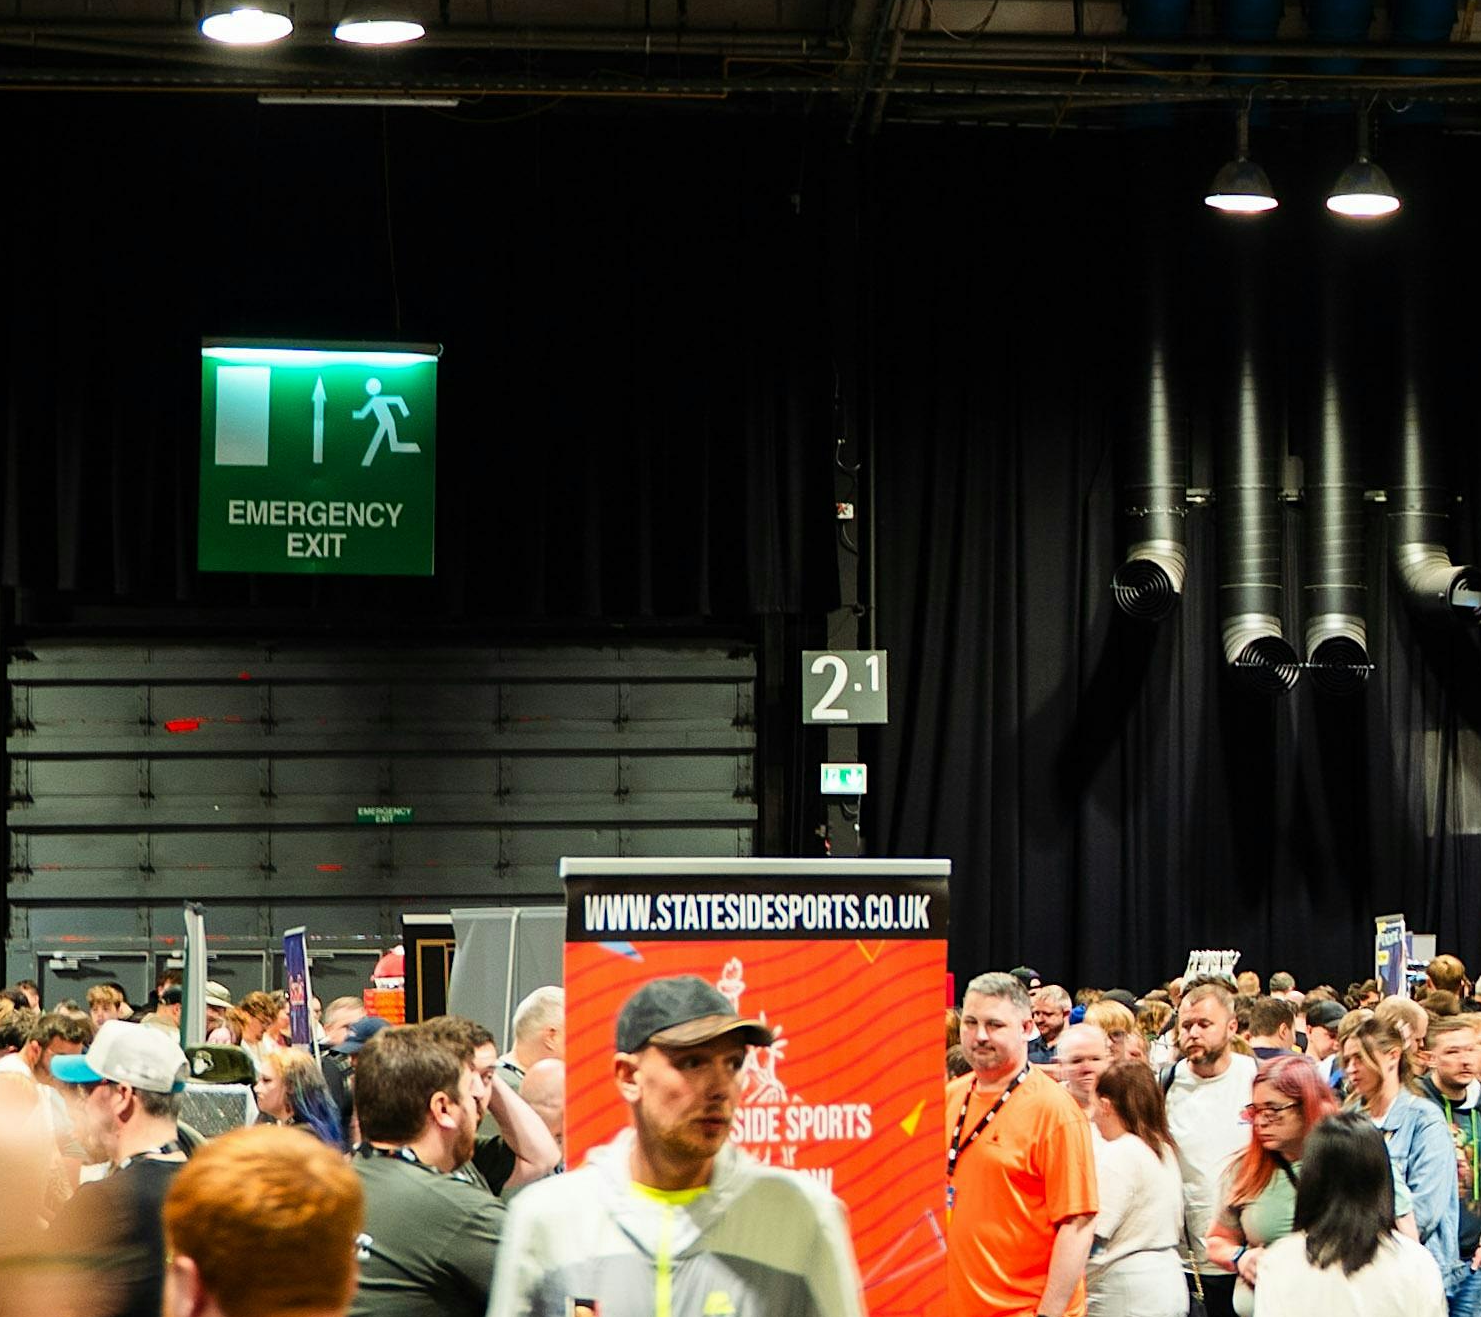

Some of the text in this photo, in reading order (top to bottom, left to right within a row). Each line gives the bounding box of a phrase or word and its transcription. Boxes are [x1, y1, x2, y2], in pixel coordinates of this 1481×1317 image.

[229, 499, 403, 528] EMERGENCY
[287, 532, 347, 558] EXIT
[811, 654, 879, 720] 2.1
[358, 806, 412, 815] EMERGENCY
[584, 893, 932, 931] WWW.STATESIDESPORTS.CO.UK
[729, 1103, 873, 1144] SIDE SPORTS
